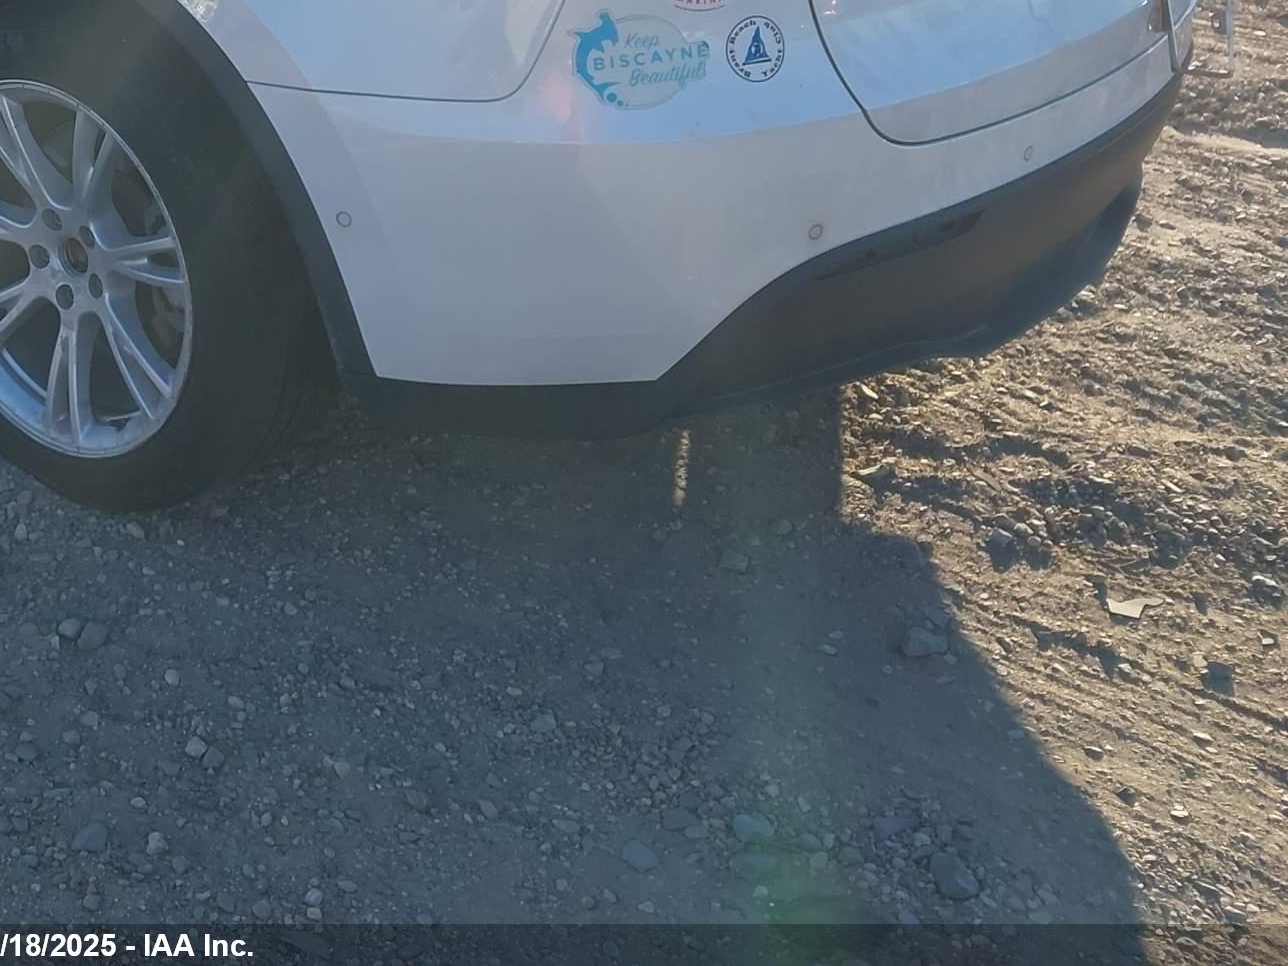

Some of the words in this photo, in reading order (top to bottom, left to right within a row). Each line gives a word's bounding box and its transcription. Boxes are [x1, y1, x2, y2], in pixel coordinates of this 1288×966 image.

[624, 33, 660, 50] Keep
[729, 19, 756, 44] Beach
[763, 21, 781, 44] Club
[593, 43, 708, 70] BISCAYNE
